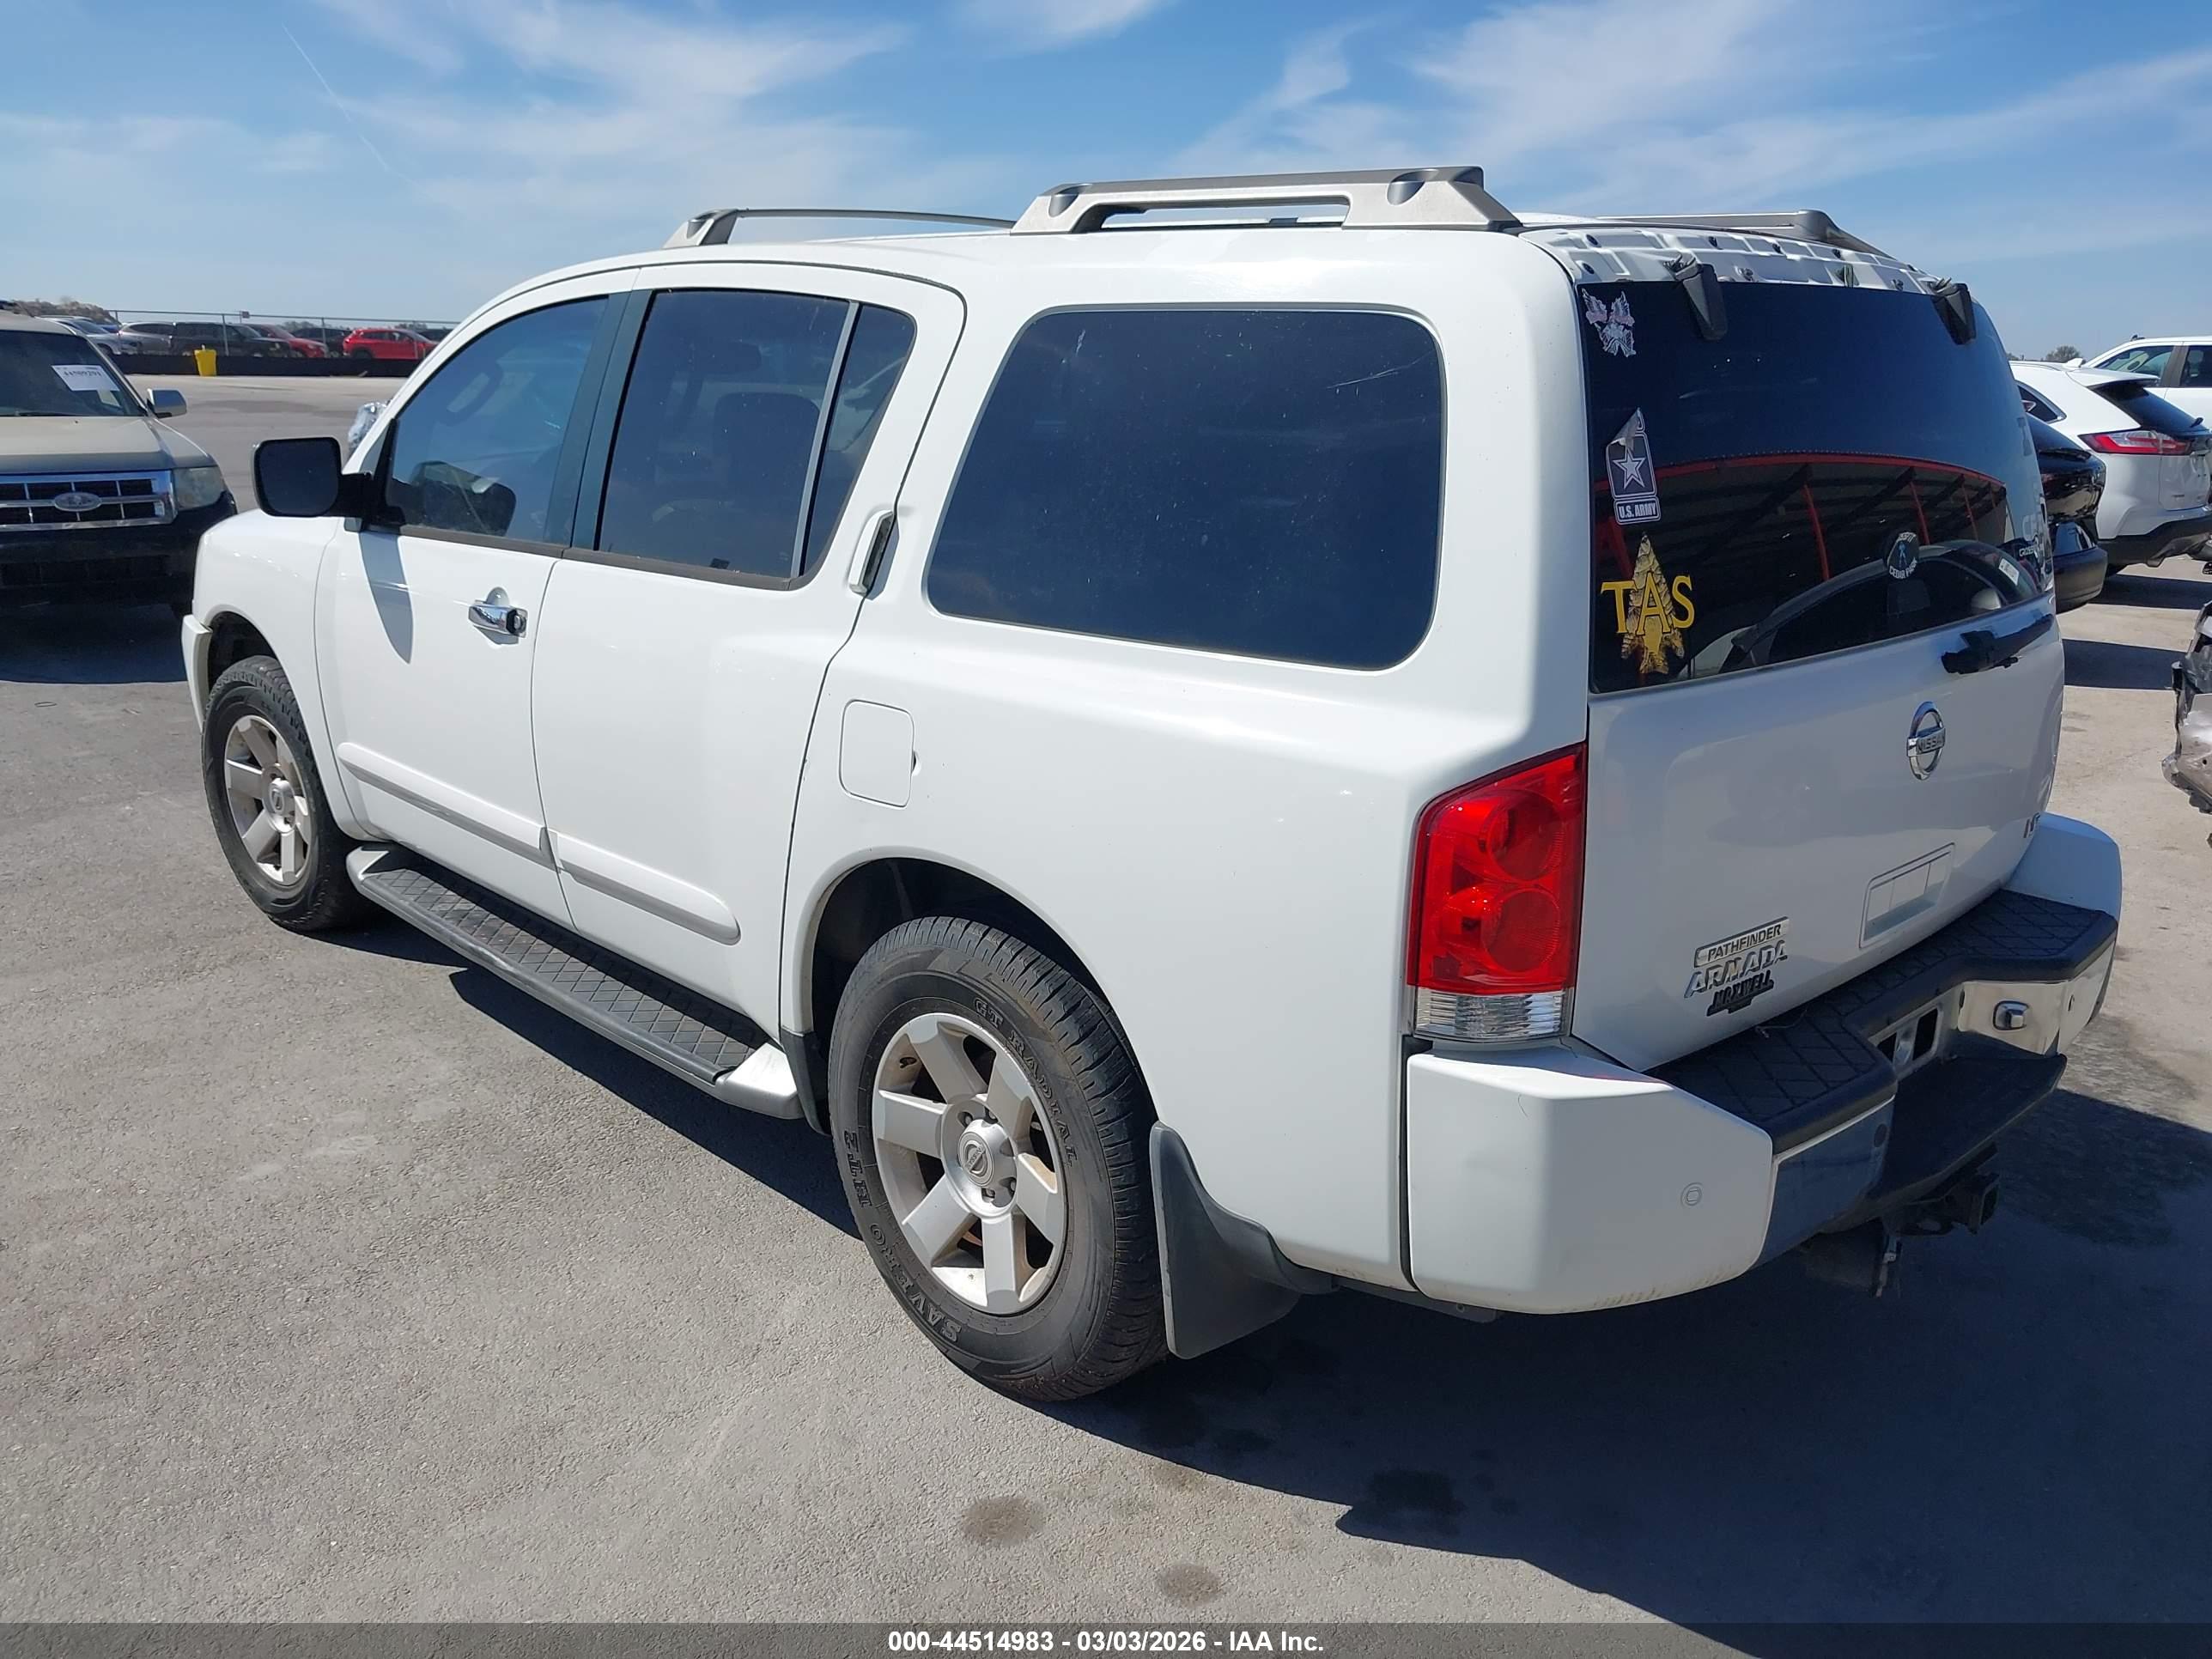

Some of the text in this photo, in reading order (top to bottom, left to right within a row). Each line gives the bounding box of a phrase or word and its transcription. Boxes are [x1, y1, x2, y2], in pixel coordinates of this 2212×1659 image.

[1619, 503, 1656, 519] U.S. ARMY
[1601, 571, 1695, 635] TAS
[1684, 940, 1788, 998] ARMADA
[1708, 924, 1781, 962] PATHFINDER
[1711, 969, 1773, 1007] MAXWELL
[973, 997, 1077, 1169] GT RADIAL
[870, 1224, 962, 1343] SAVERO
